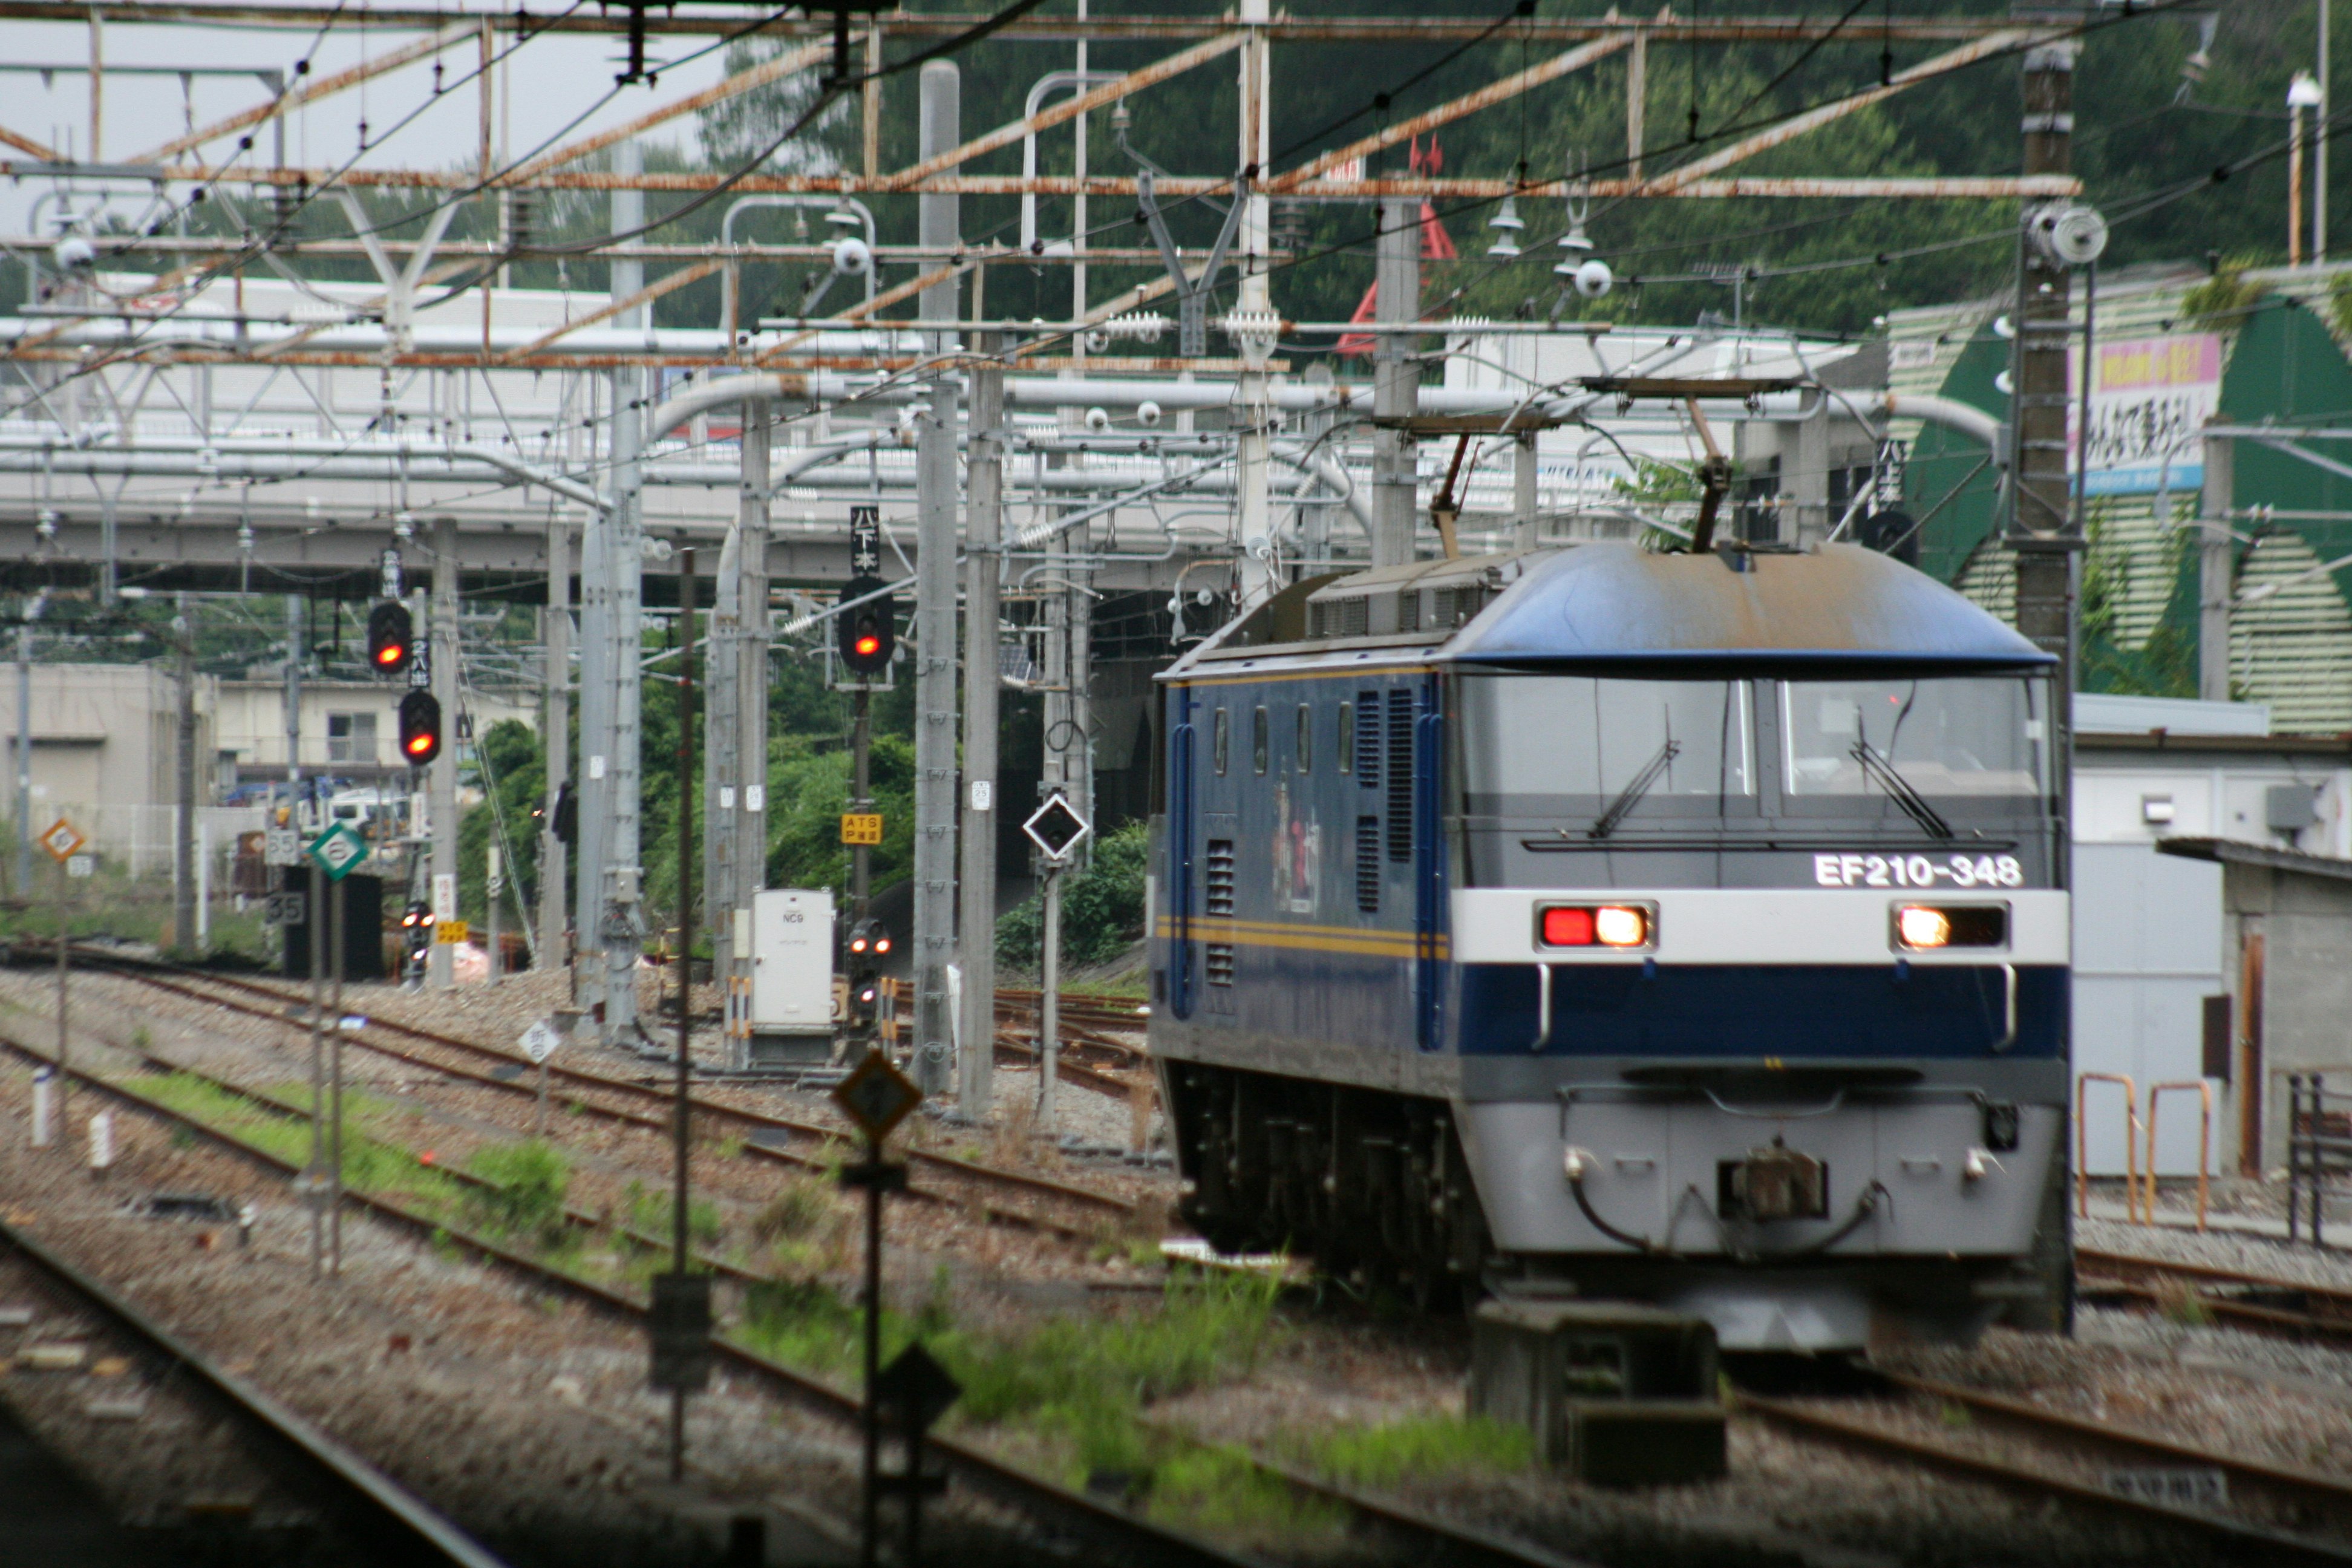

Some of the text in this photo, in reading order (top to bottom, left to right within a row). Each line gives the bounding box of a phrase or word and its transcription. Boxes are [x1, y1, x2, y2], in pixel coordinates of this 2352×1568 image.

[854, 508, 877, 570] 八下本
[846, 817, 877, 828] ATS
[1814, 854, 2024, 887] EF210-348
